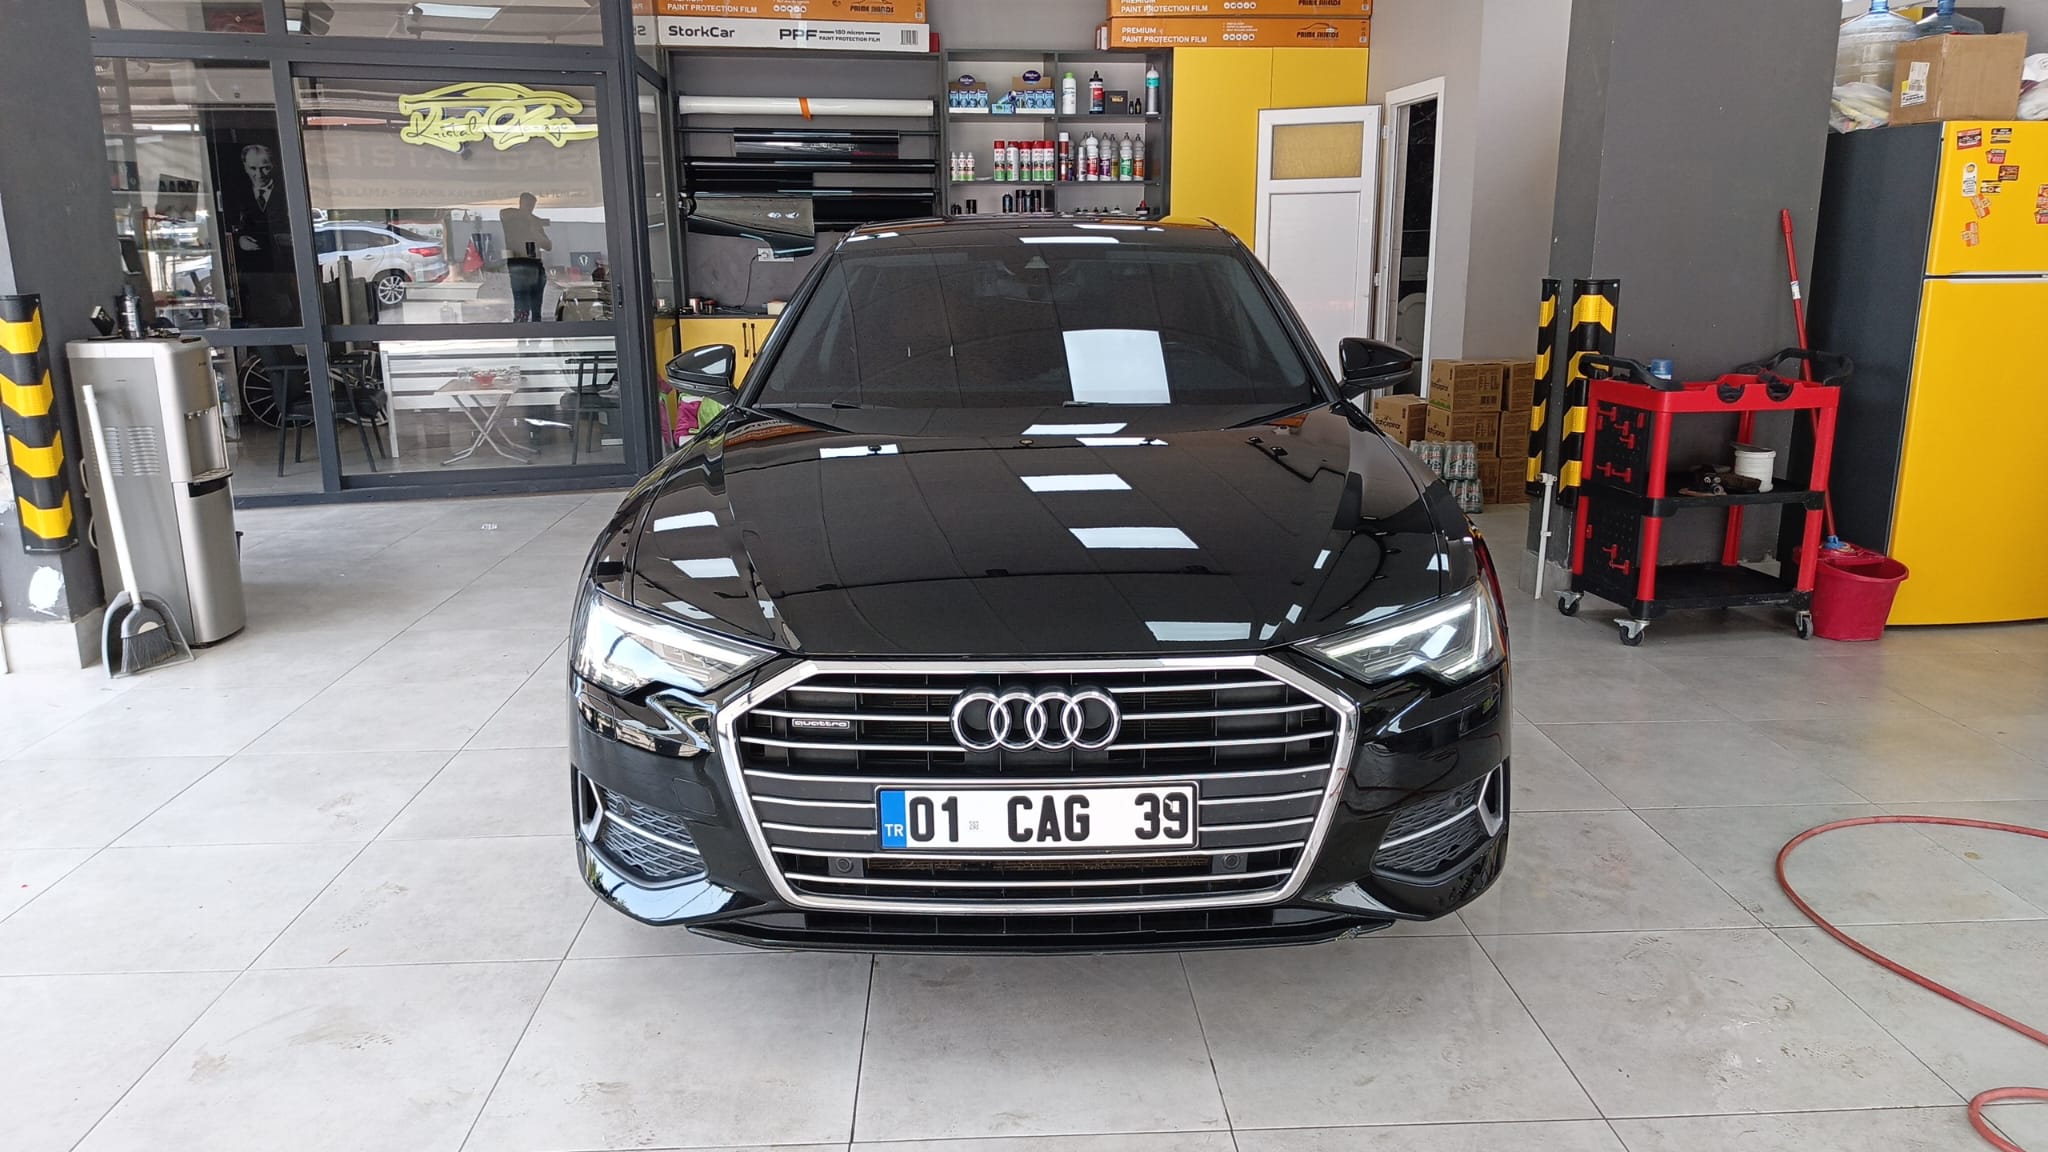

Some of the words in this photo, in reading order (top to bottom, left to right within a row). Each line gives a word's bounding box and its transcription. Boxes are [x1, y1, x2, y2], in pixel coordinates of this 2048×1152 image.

[667, 3, 689, 11] PAINT
[691, 4, 738, 12] PROTECTION
[1191, 4, 1208, 12] FILM
[668, 25, 735, 38] StorkCar
[779, 28, 817, 40] PPF
[406, 111, 478, 144] Kristal
[794, 720, 848, 728] quattro
[909, 796, 959, 843] 01
[1007, 794, 1091, 842] CAG
[1134, 792, 1189, 840] 39
[884, 823, 904, 837] TR
